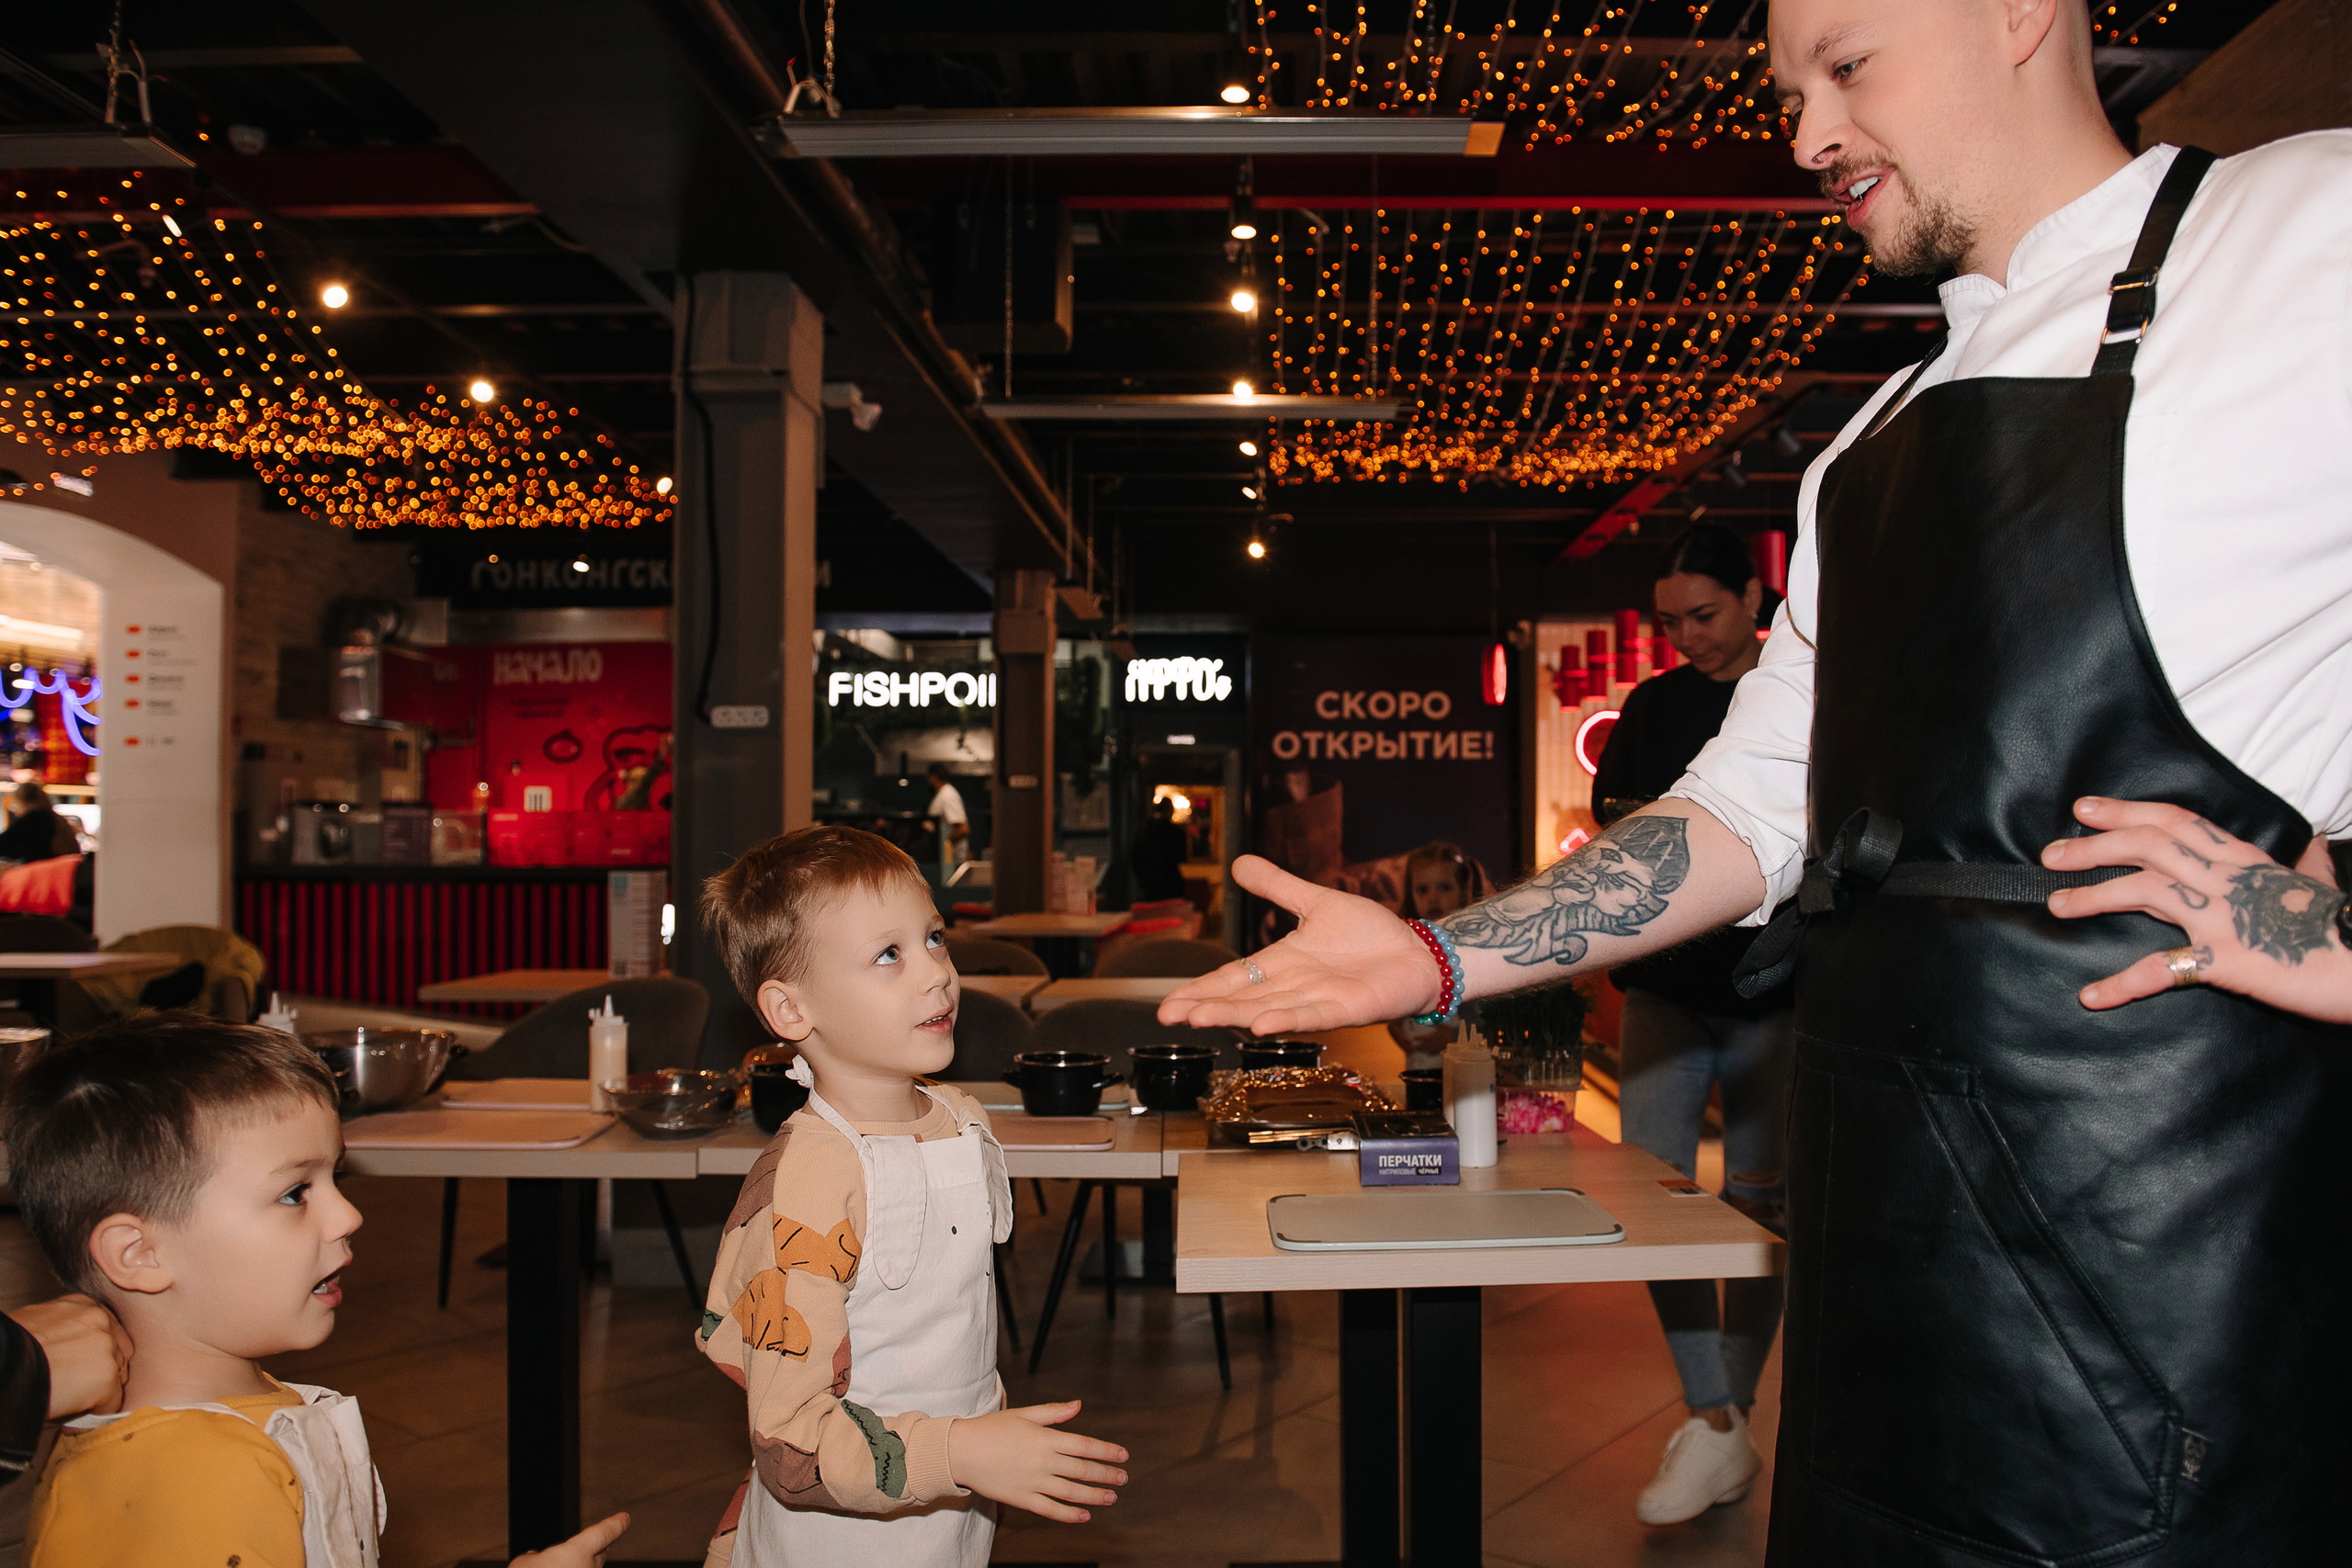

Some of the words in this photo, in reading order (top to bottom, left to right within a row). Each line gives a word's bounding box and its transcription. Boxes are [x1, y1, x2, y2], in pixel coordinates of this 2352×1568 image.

[470, 558, 674, 590] ГОНКОНГСК
[1315, 690, 1452, 720] СКОРО
[1272, 730, 1495, 761] ОТКРЫТИЕ!
[1378, 1154, 1442, 1168] ПЕРЧАТКИ
